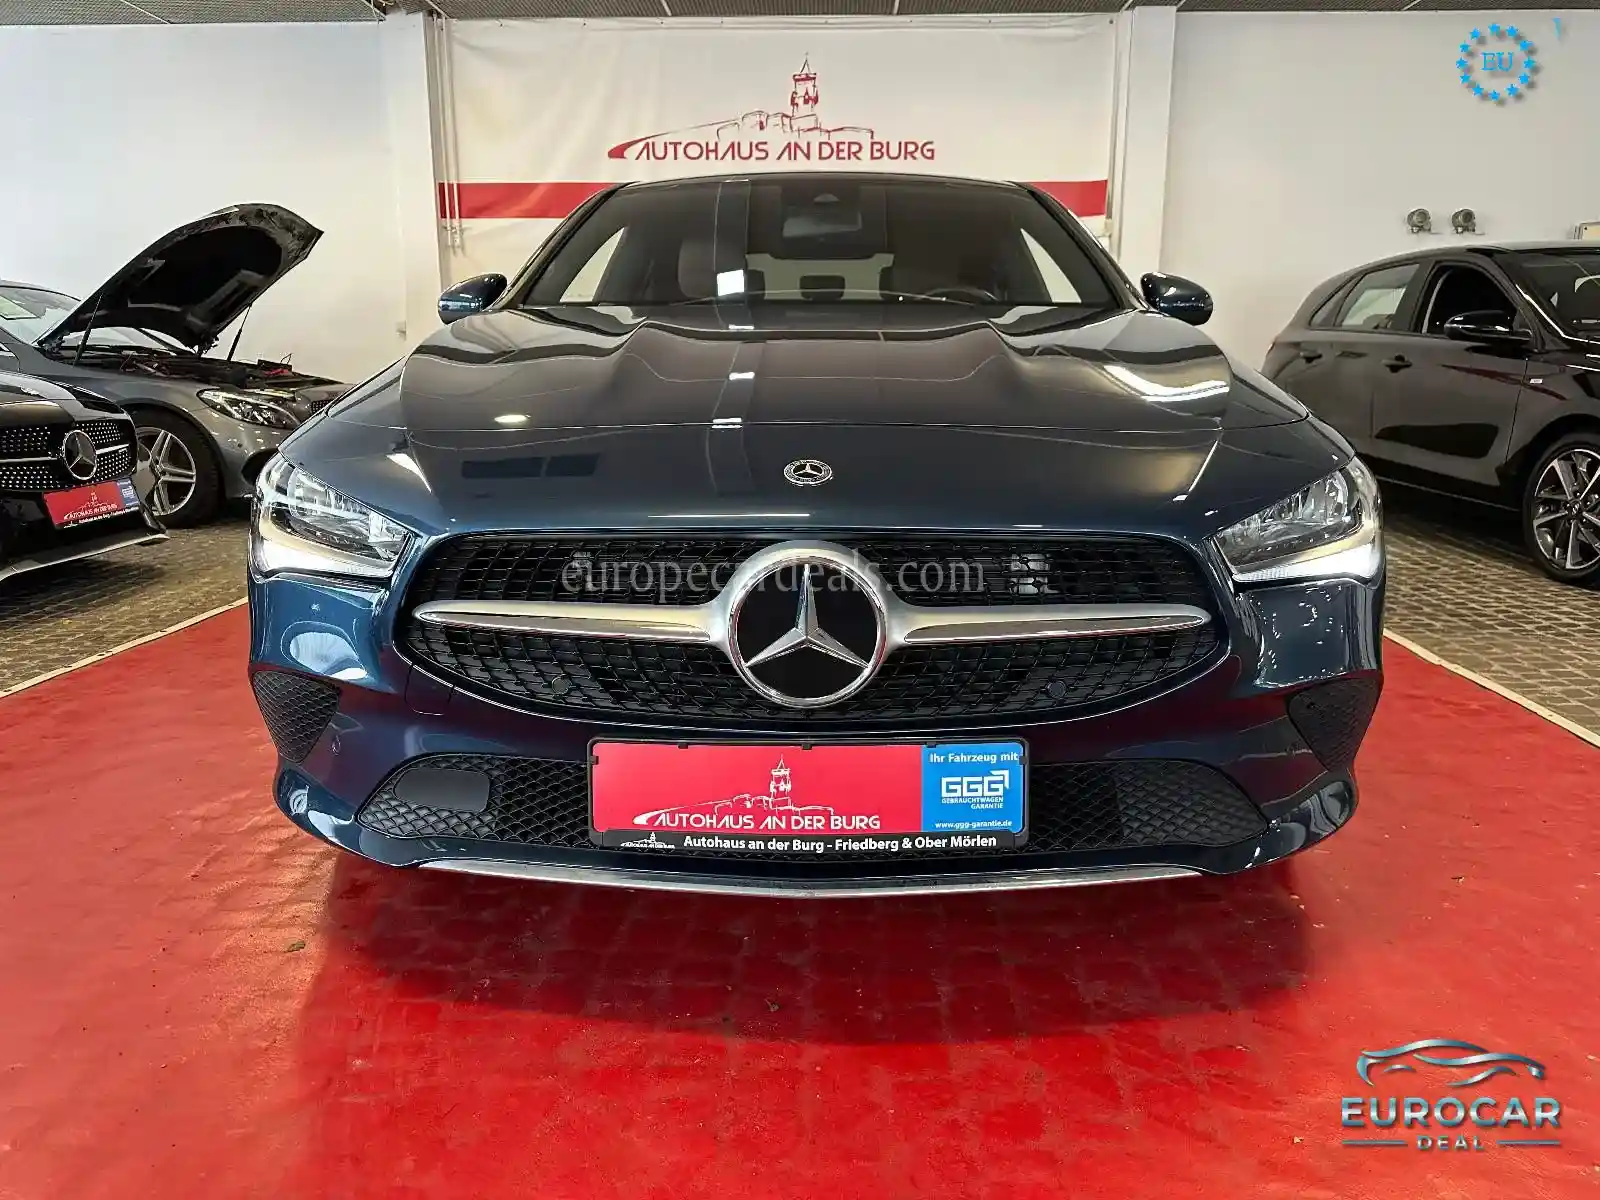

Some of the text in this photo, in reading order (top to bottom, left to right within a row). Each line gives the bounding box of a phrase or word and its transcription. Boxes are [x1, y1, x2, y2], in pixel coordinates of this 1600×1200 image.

[635, 141, 935, 160] AUTOHAUS AN DER BURG
[929, 752, 1019, 764] Ihr Fahrzeug mit
[941, 776, 1004, 798] GGG
[653, 813, 881, 831] AUTOHAUS AN DER BURG
[935, 820, 1012, 830] www.ggg-garantie.de
[683, 835, 746, 849] Autohaus
[748, 839, 764, 850] an
[767, 838, 789, 851] der
[792, 839, 824, 853] Burg
[835, 838, 899, 852] Friedberg
[901, 837, 912, 849] &
[914, 836, 948, 849] Ober
[950, 834, 997, 848] Mörlen
